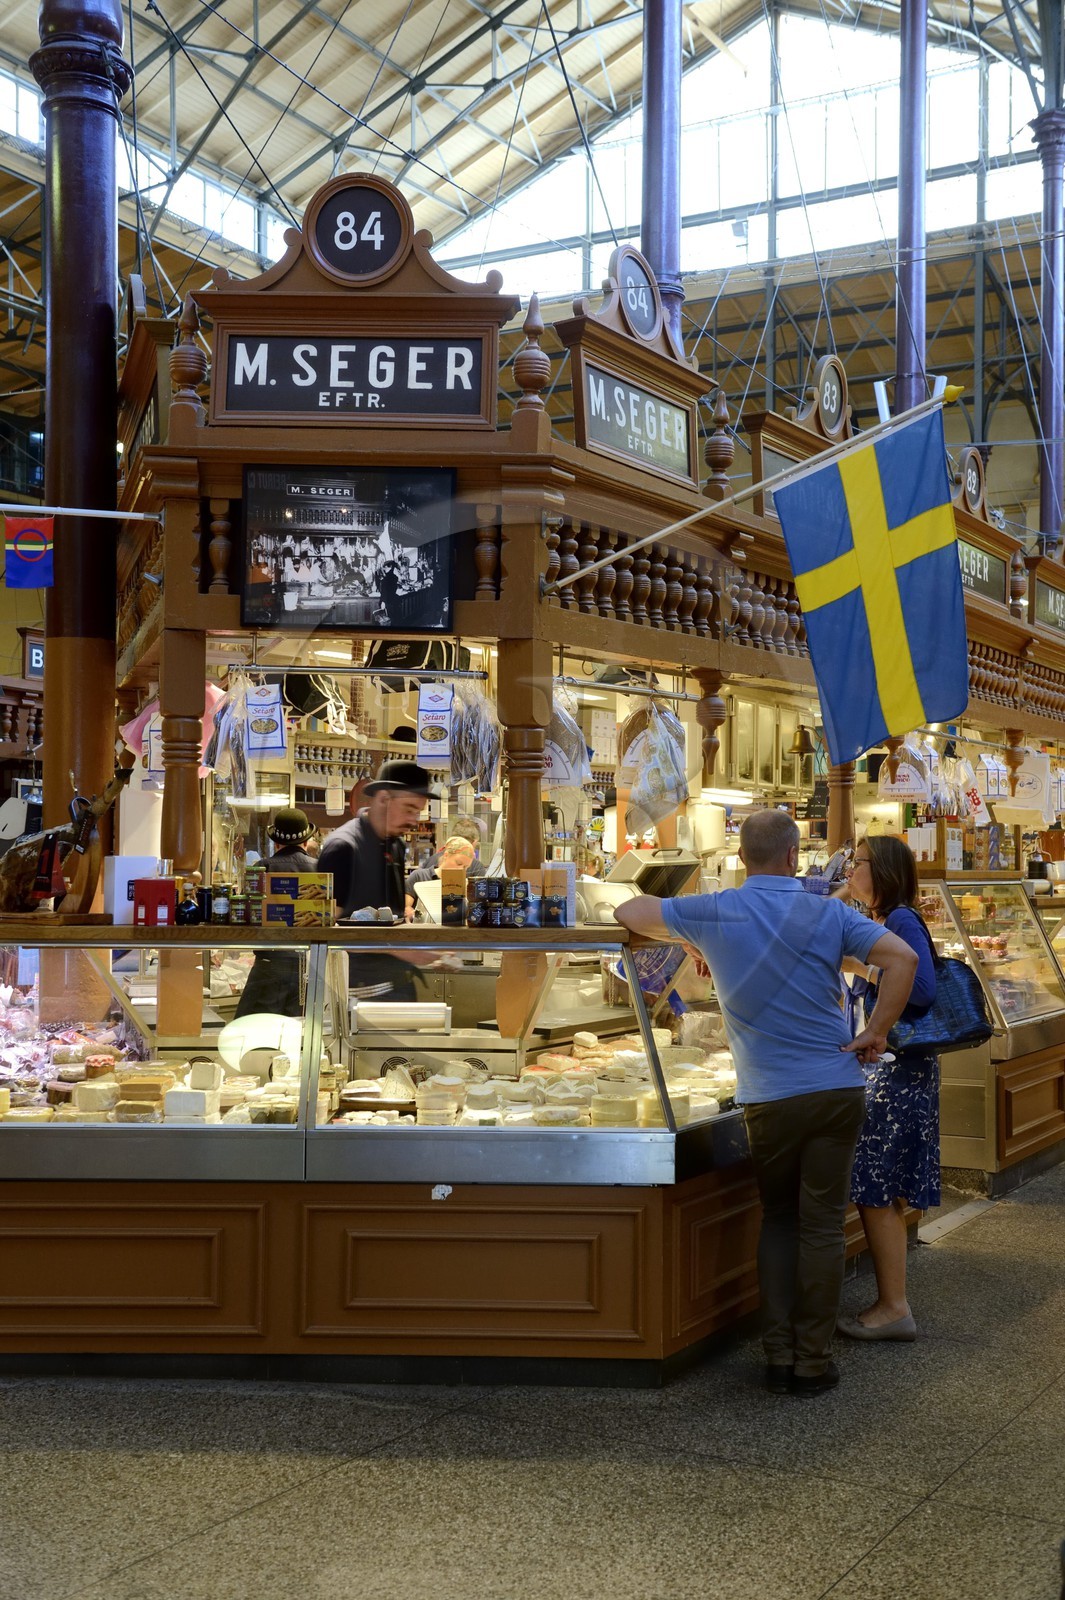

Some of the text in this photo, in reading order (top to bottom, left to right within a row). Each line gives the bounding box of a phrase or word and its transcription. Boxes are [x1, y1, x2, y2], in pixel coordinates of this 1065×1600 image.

[333, 211, 385, 251] 84
[627, 276, 648, 318] 84
[234, 342, 474, 390] M. SEGER
[318, 391, 386, 408] EFTR.
[589, 374, 686, 453] M. SEGER
[823, 381, 838, 414] 83
[627, 434, 656, 458] EFTR.
[291, 486, 351, 497] M. SEGER
[967, 468, 977, 495] 82
[957, 544, 989, 583] SEGER
